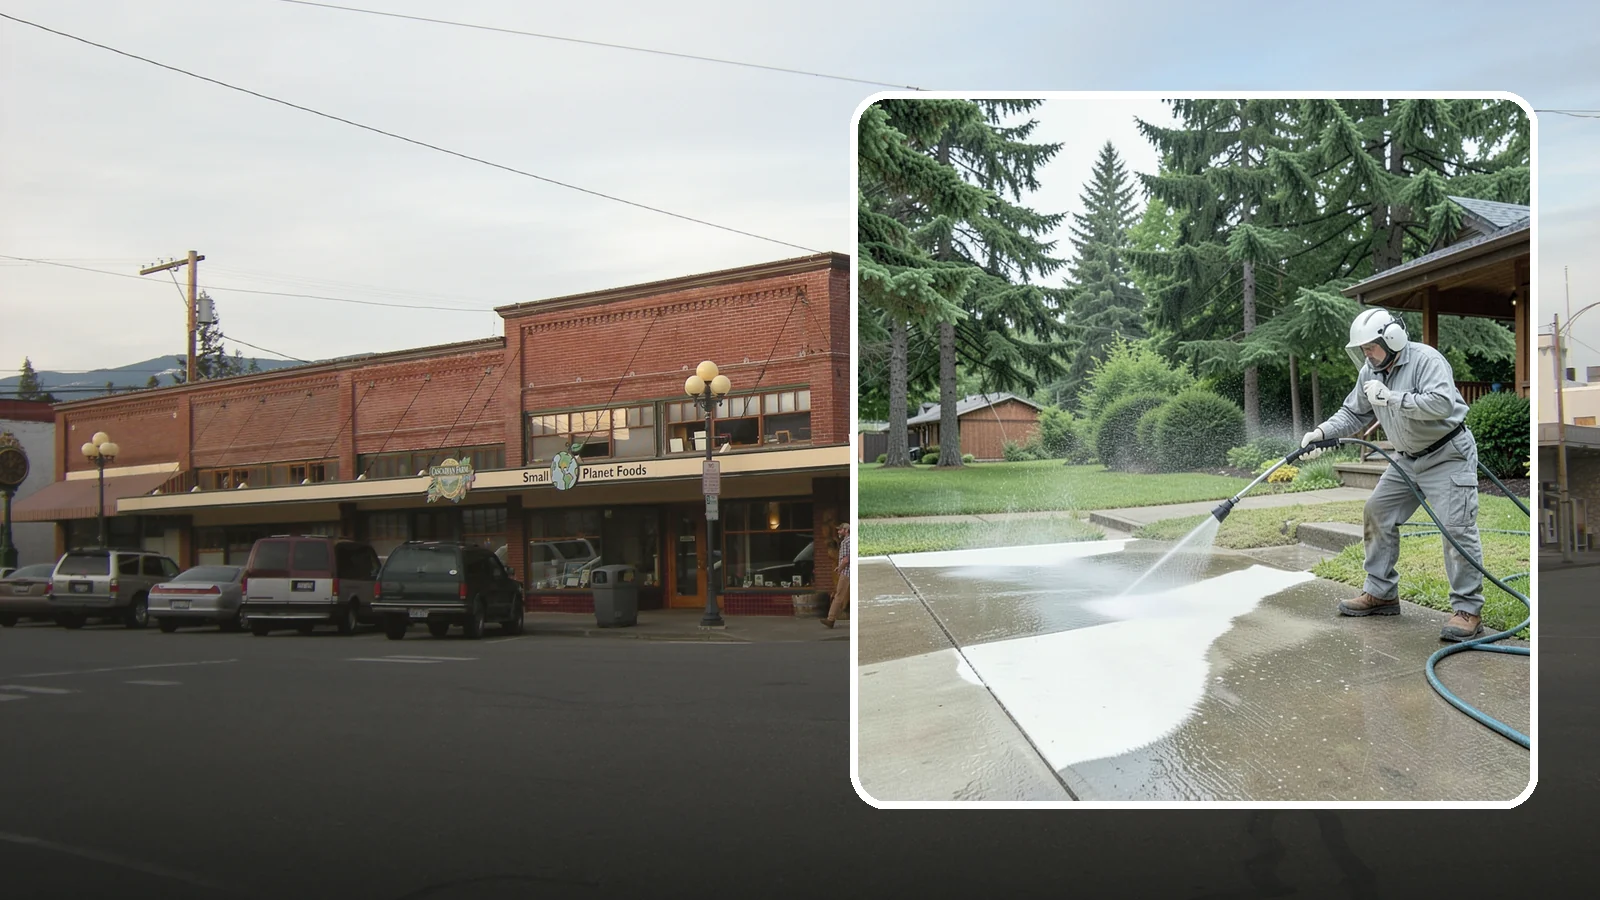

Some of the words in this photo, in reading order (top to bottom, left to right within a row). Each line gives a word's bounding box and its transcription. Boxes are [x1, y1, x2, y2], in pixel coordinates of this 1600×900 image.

[523, 471, 549, 482] Small
[583, 468, 614, 479] Planet
[617, 464, 647, 477] Foods
